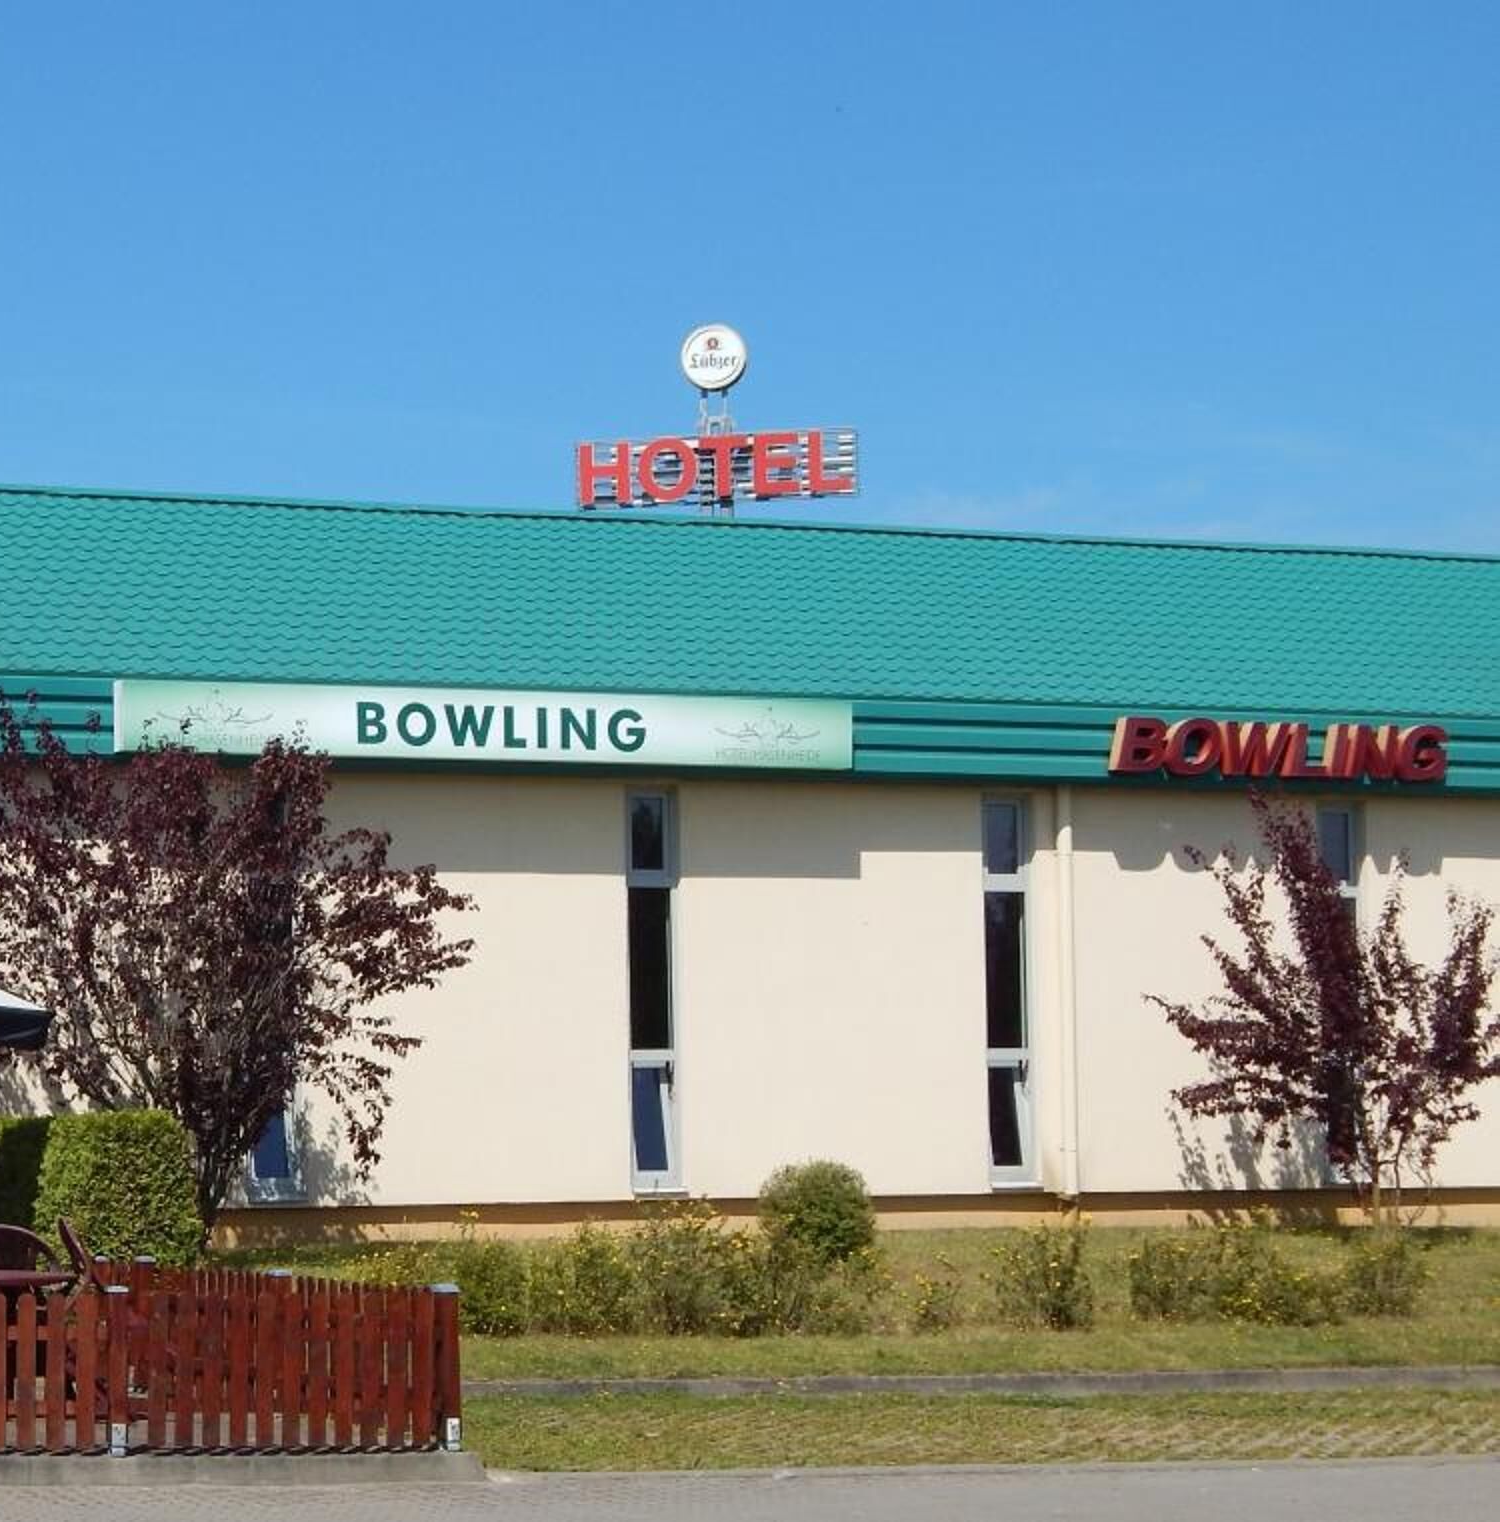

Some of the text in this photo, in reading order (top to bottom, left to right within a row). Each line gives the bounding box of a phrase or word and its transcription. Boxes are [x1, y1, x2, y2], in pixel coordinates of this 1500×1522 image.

[577, 431, 854, 506] HOTEL
[356, 701, 647, 752] BOWLING
[1108, 716, 1447, 782] BOWLING
